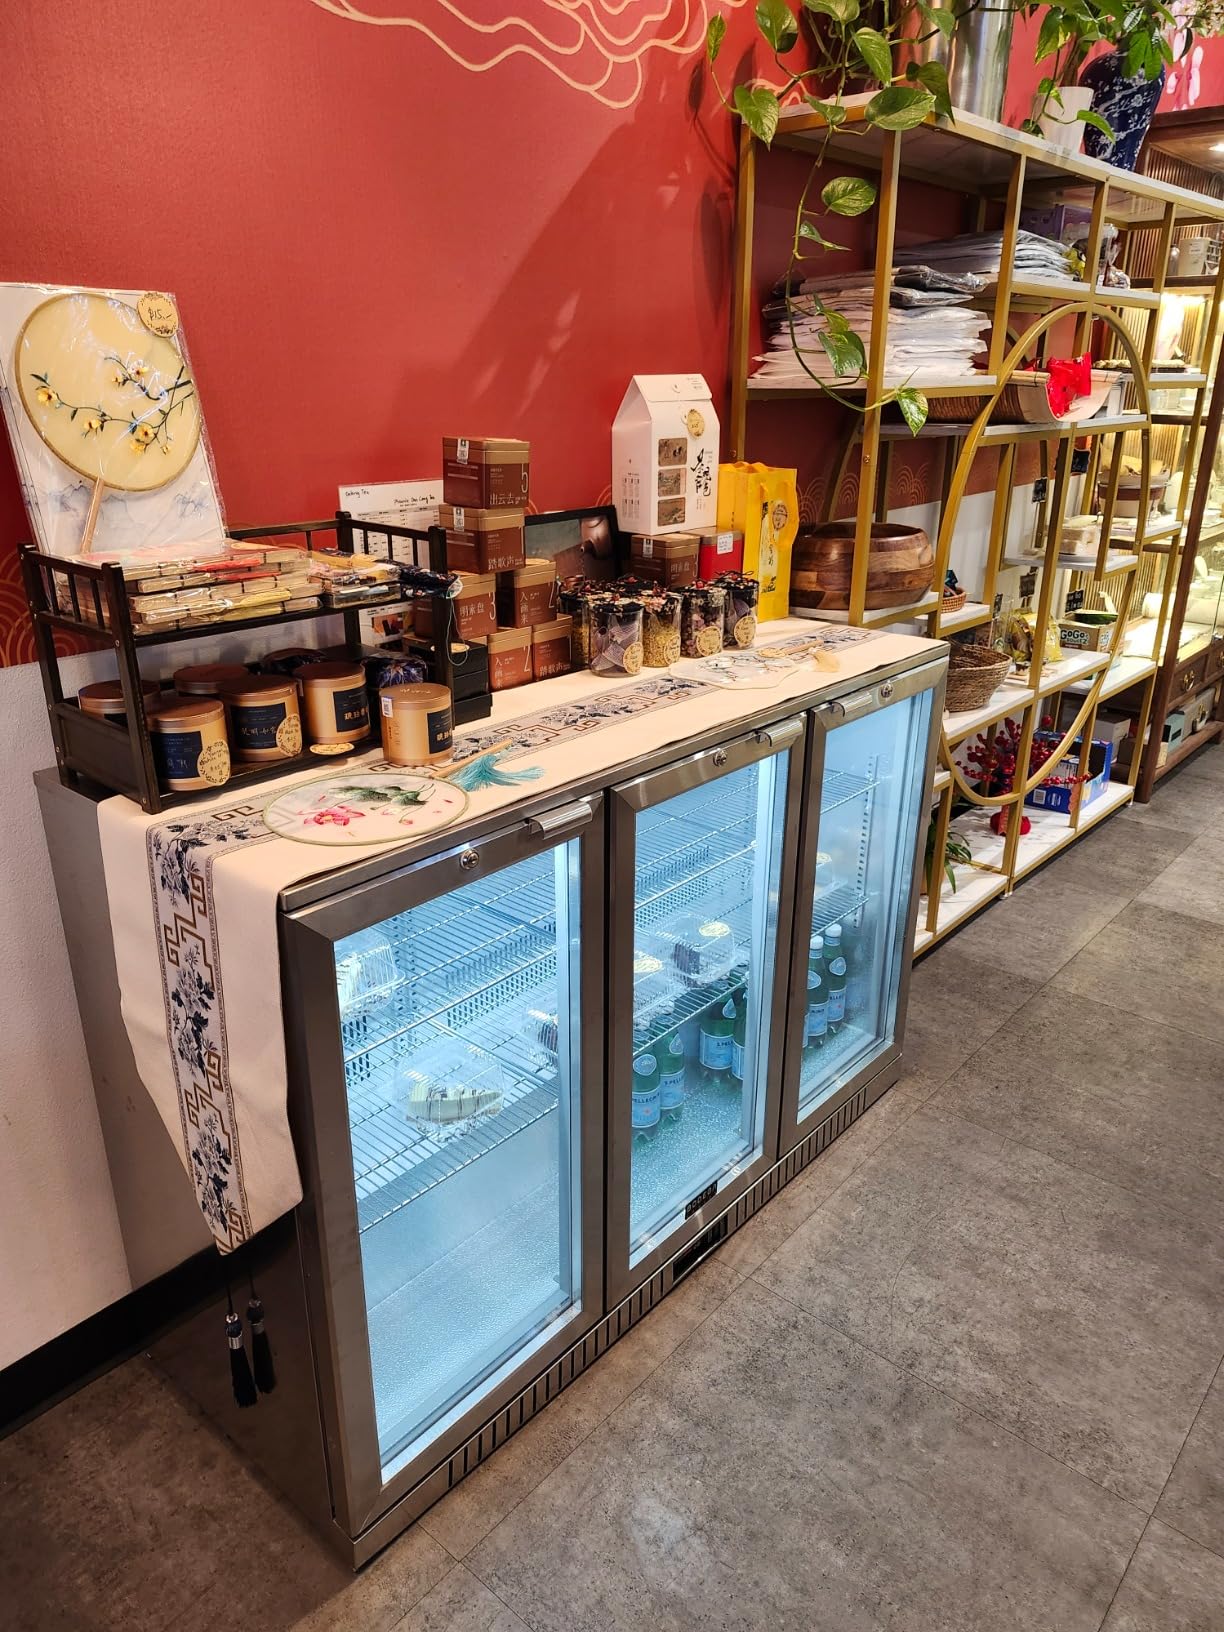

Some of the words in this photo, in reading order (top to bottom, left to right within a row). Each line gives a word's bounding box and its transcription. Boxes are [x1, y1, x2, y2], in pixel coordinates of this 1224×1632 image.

[521, 463, 529, 493] 5
[488, 592, 497, 620] 3
[523, 645, 531, 673] 2
